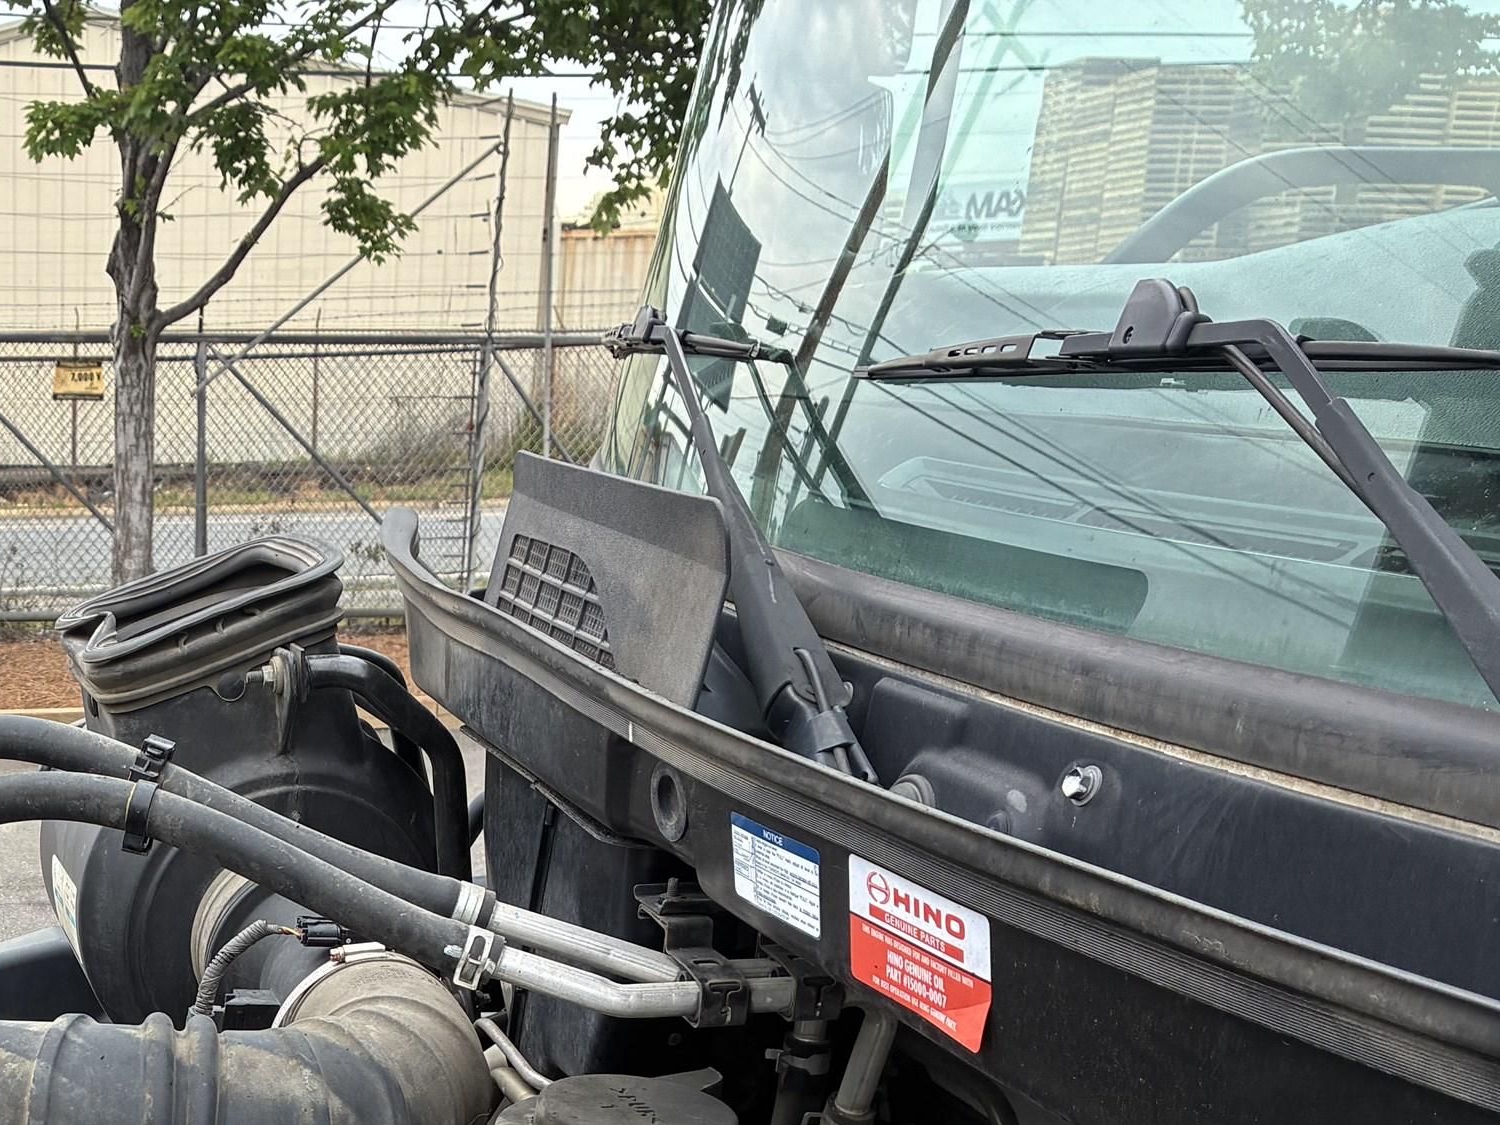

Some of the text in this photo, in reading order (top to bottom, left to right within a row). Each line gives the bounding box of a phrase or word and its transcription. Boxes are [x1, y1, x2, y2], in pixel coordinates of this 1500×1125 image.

[762, 829, 783, 847] NOTICE
[884, 912, 947, 953] GENUINE PARTS
[893, 887, 966, 941] HINO
[886, 963, 902, 985] PART
[887, 948, 945, 993] HINO GENUINE OIL
